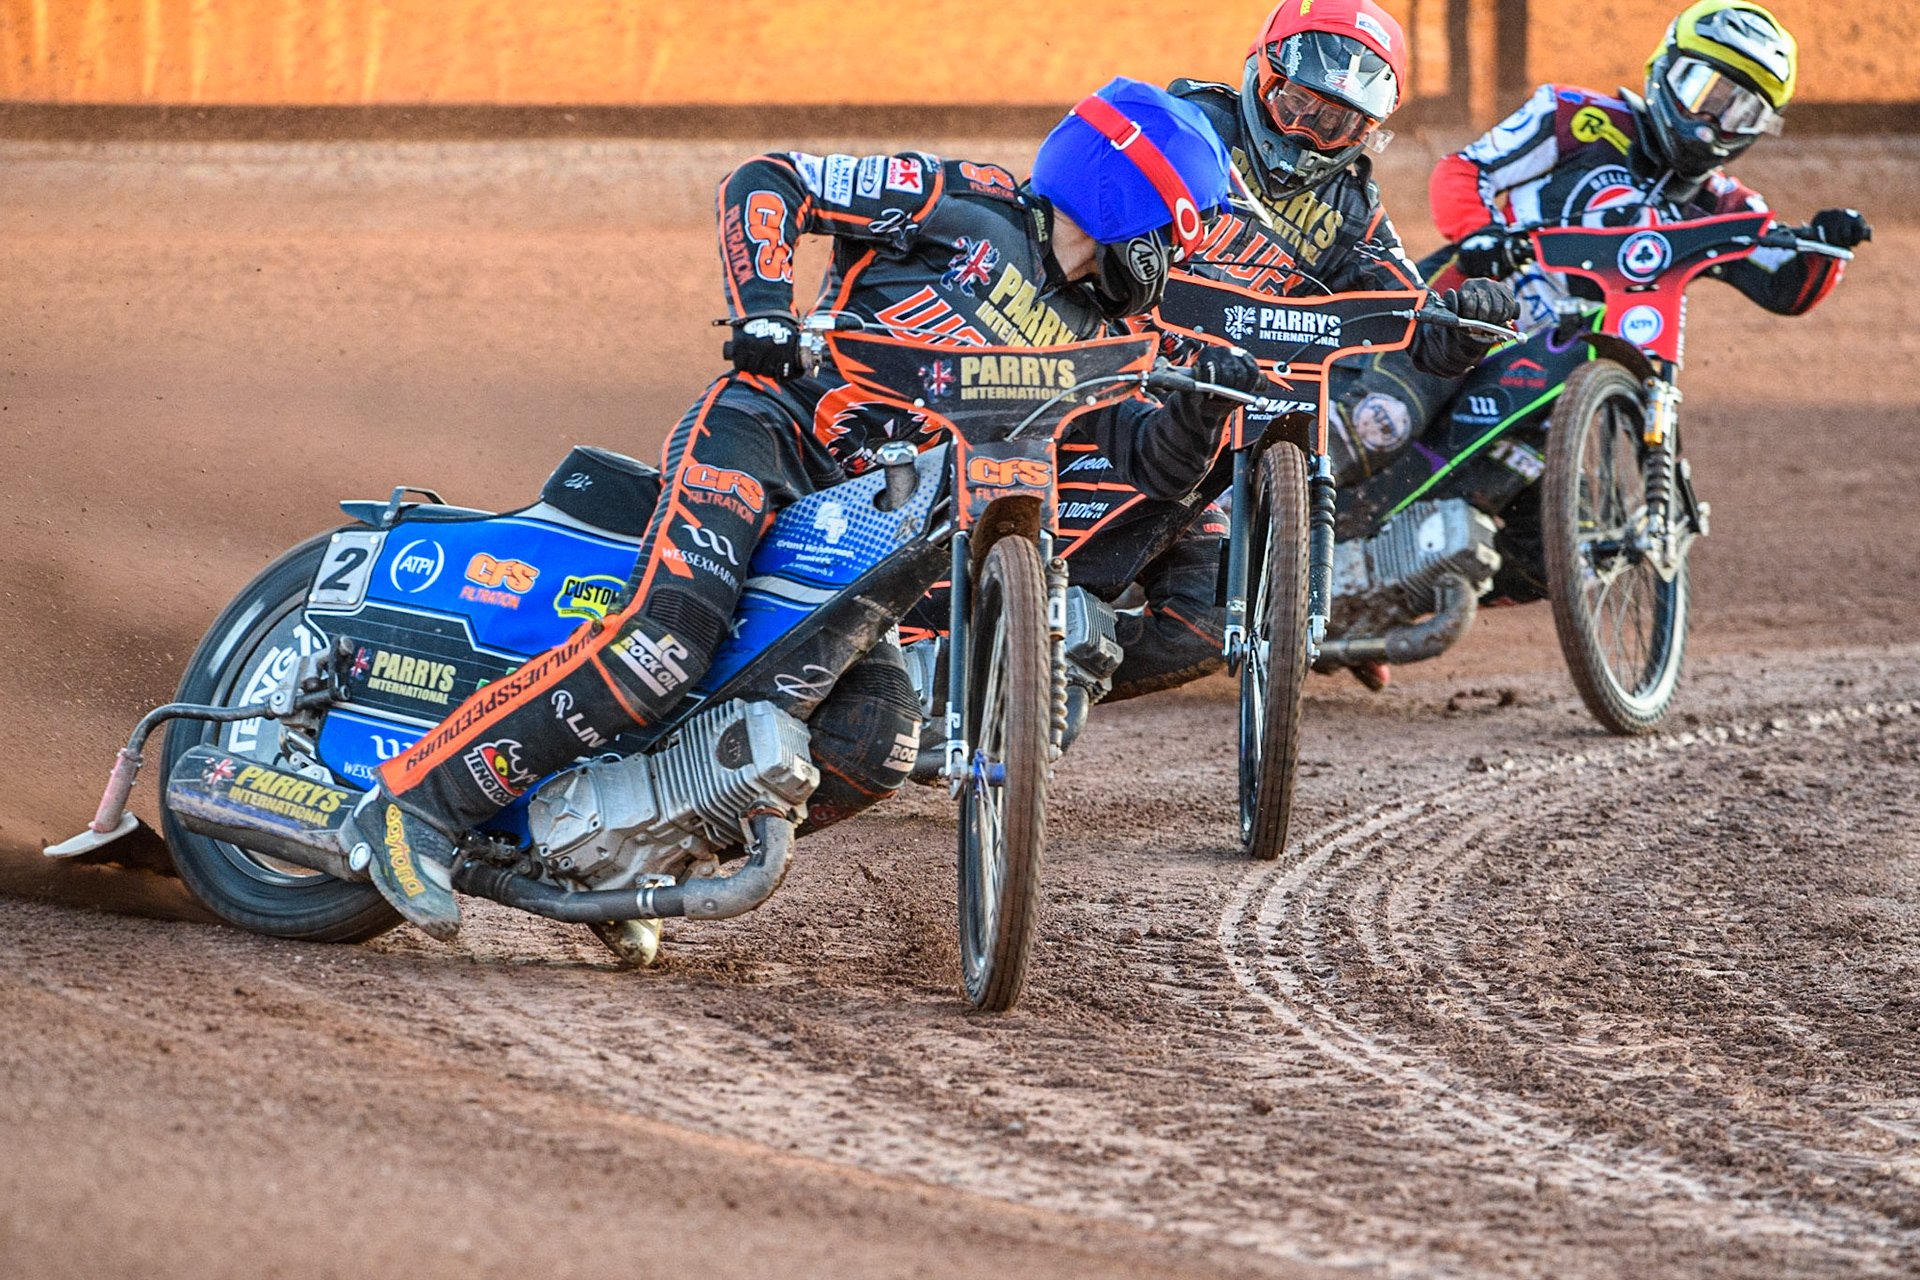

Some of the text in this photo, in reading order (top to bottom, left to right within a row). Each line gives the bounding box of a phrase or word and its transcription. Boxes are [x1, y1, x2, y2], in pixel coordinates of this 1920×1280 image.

[725, 203, 755, 286] FILTRATION
[1259, 308, 1343, 337] PARRYS
[960, 355, 1077, 388] PARRYS
[683, 464, 764, 513] CFS
[967, 456, 1052, 488] CFS
[687, 490, 755, 525] FILTRATION
[319, 547, 369, 592] 2
[399, 554, 434, 576] ATPI
[465, 553, 540, 594] CFS
[458, 586, 521, 611] FILTRATION
[372, 650, 457, 693] PARRYS
[620, 636, 681, 692] ROCK OIL
[367, 676, 450, 706] INTERNATIONAL
[228, 787, 330, 828] INTERNATIONAL
[233, 765, 349, 814] PARRYS
